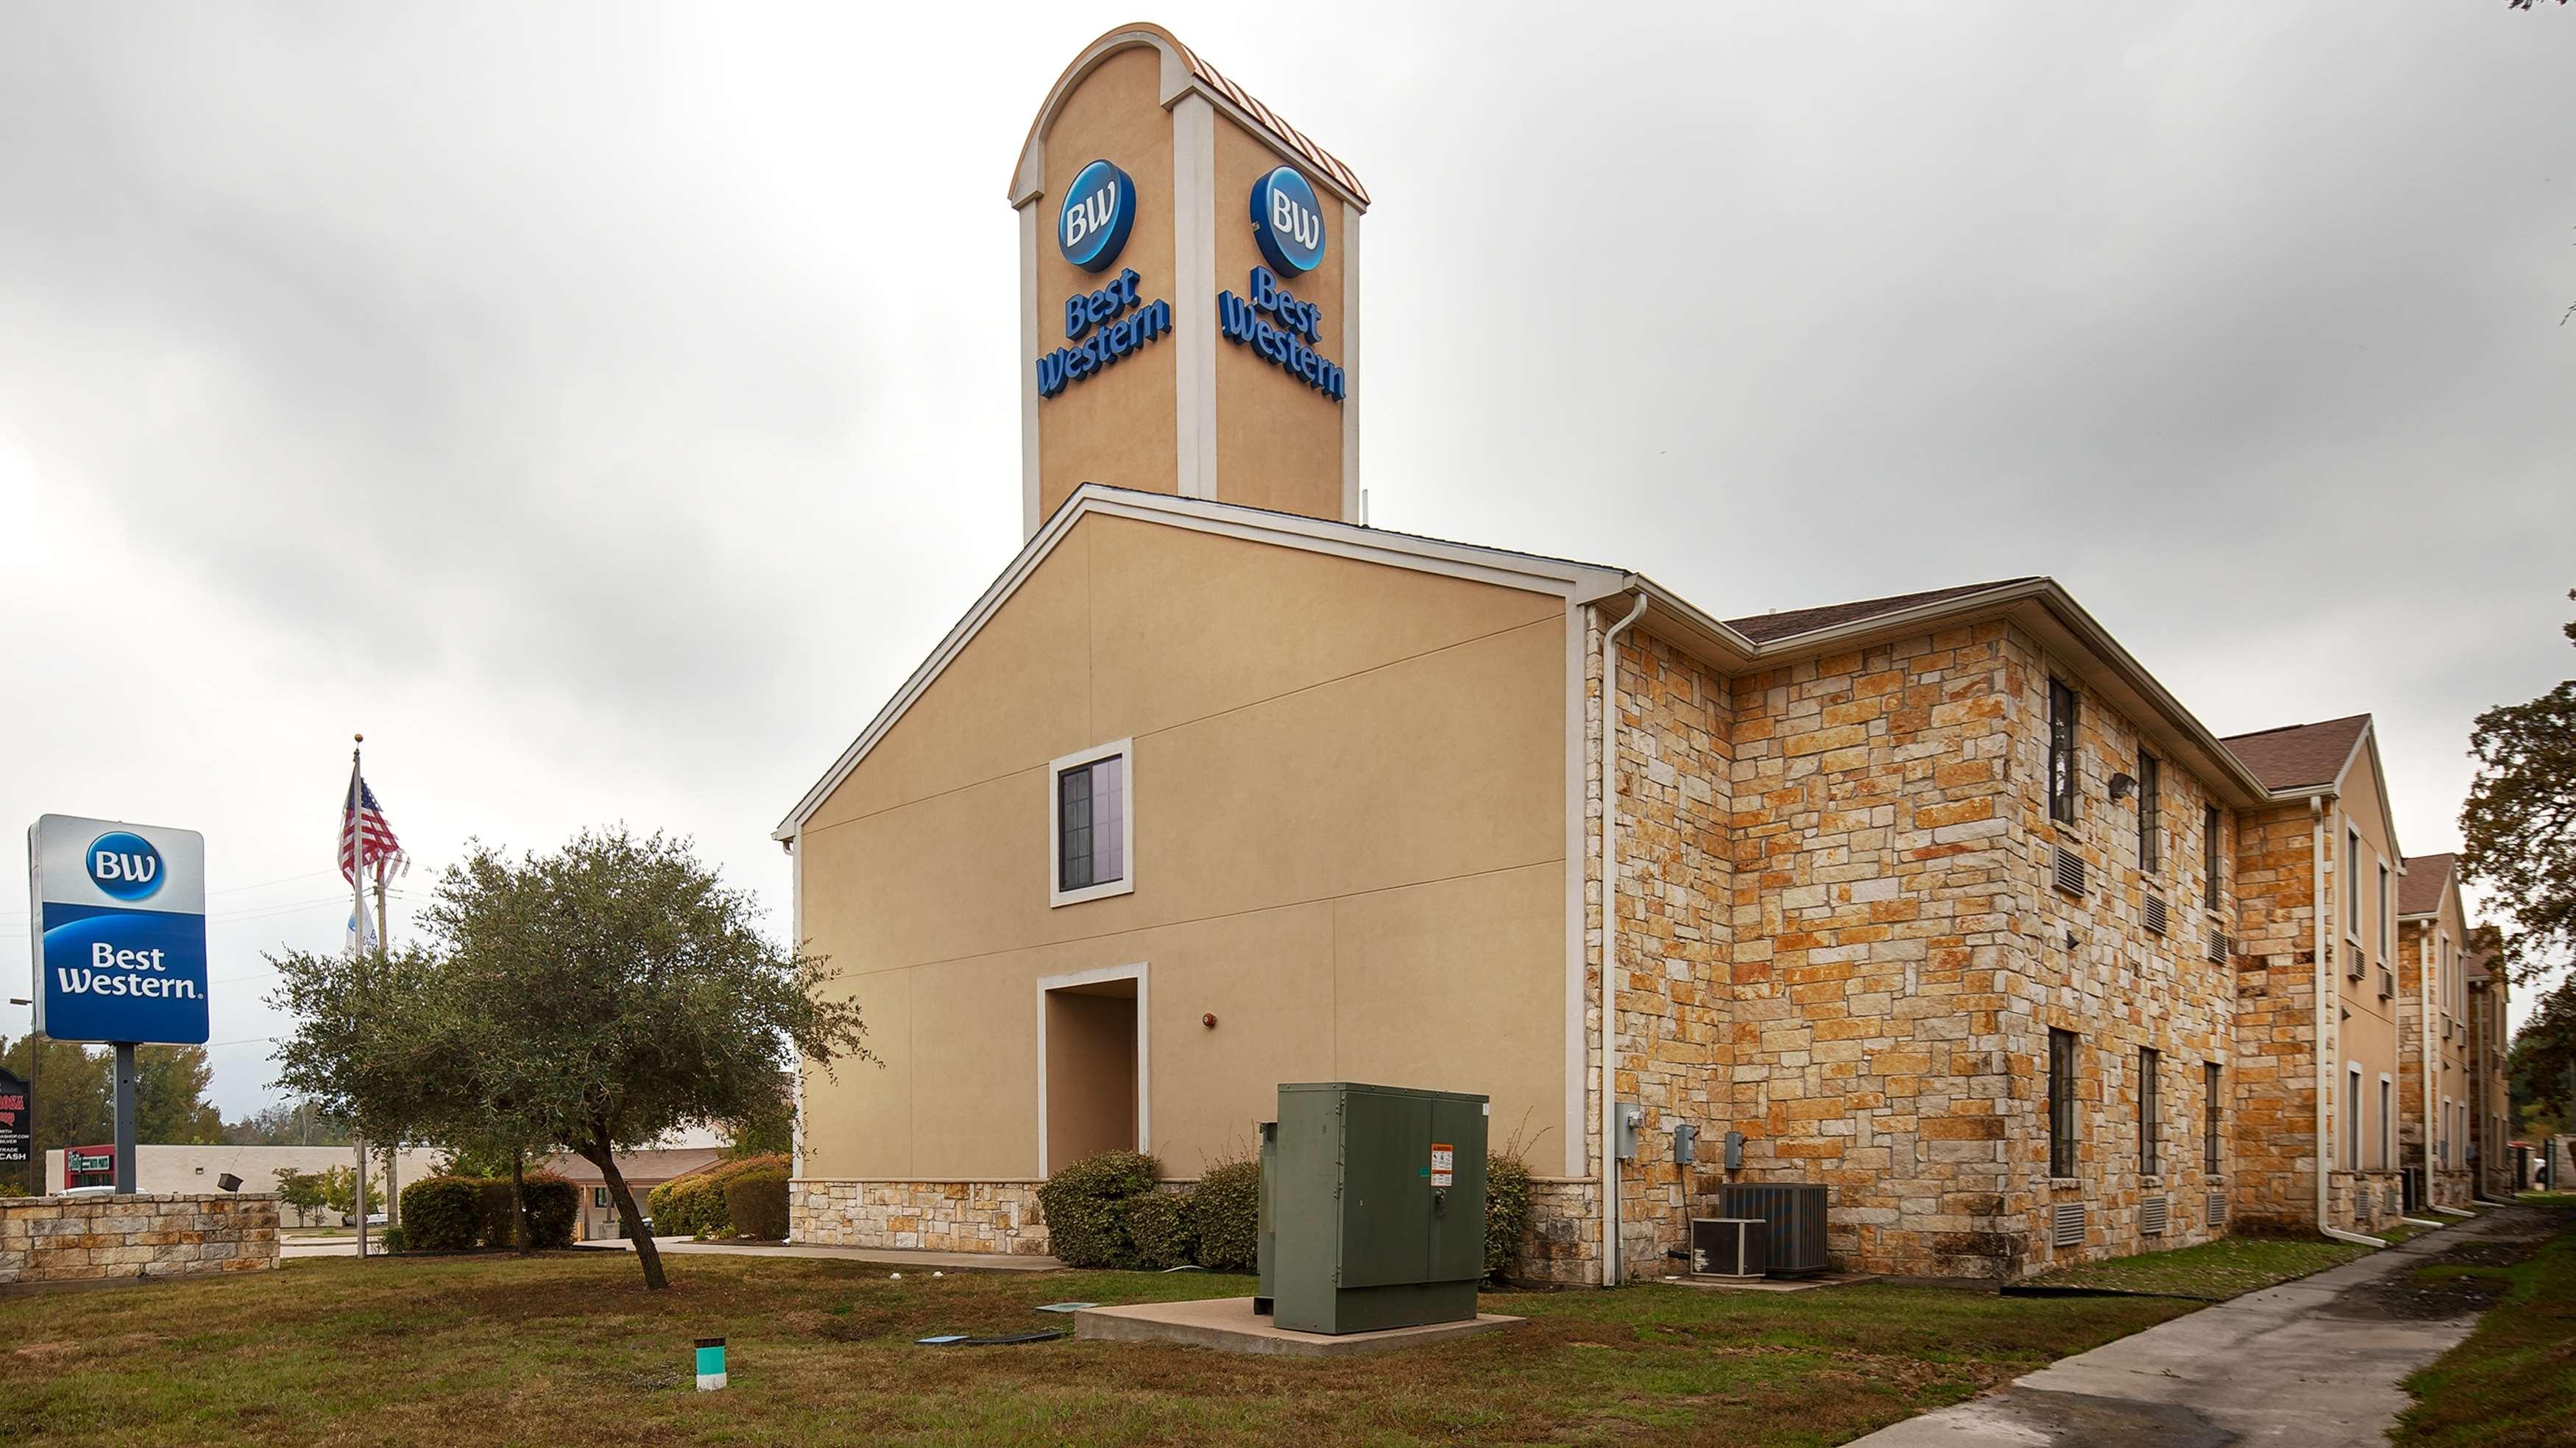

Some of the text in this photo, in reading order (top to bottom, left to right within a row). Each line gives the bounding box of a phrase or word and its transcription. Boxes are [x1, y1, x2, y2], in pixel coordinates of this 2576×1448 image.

[1067, 180, 1115, 247] BW
[1273, 188, 1320, 250] BW
[1066, 268, 1140, 341] Best
[1250, 265, 1322, 345] Best
[1036, 299, 1171, 399] Western
[1218, 290, 1346, 402] Western
[96, 851, 156, 883] BW
[92, 942, 166, 972] Best
